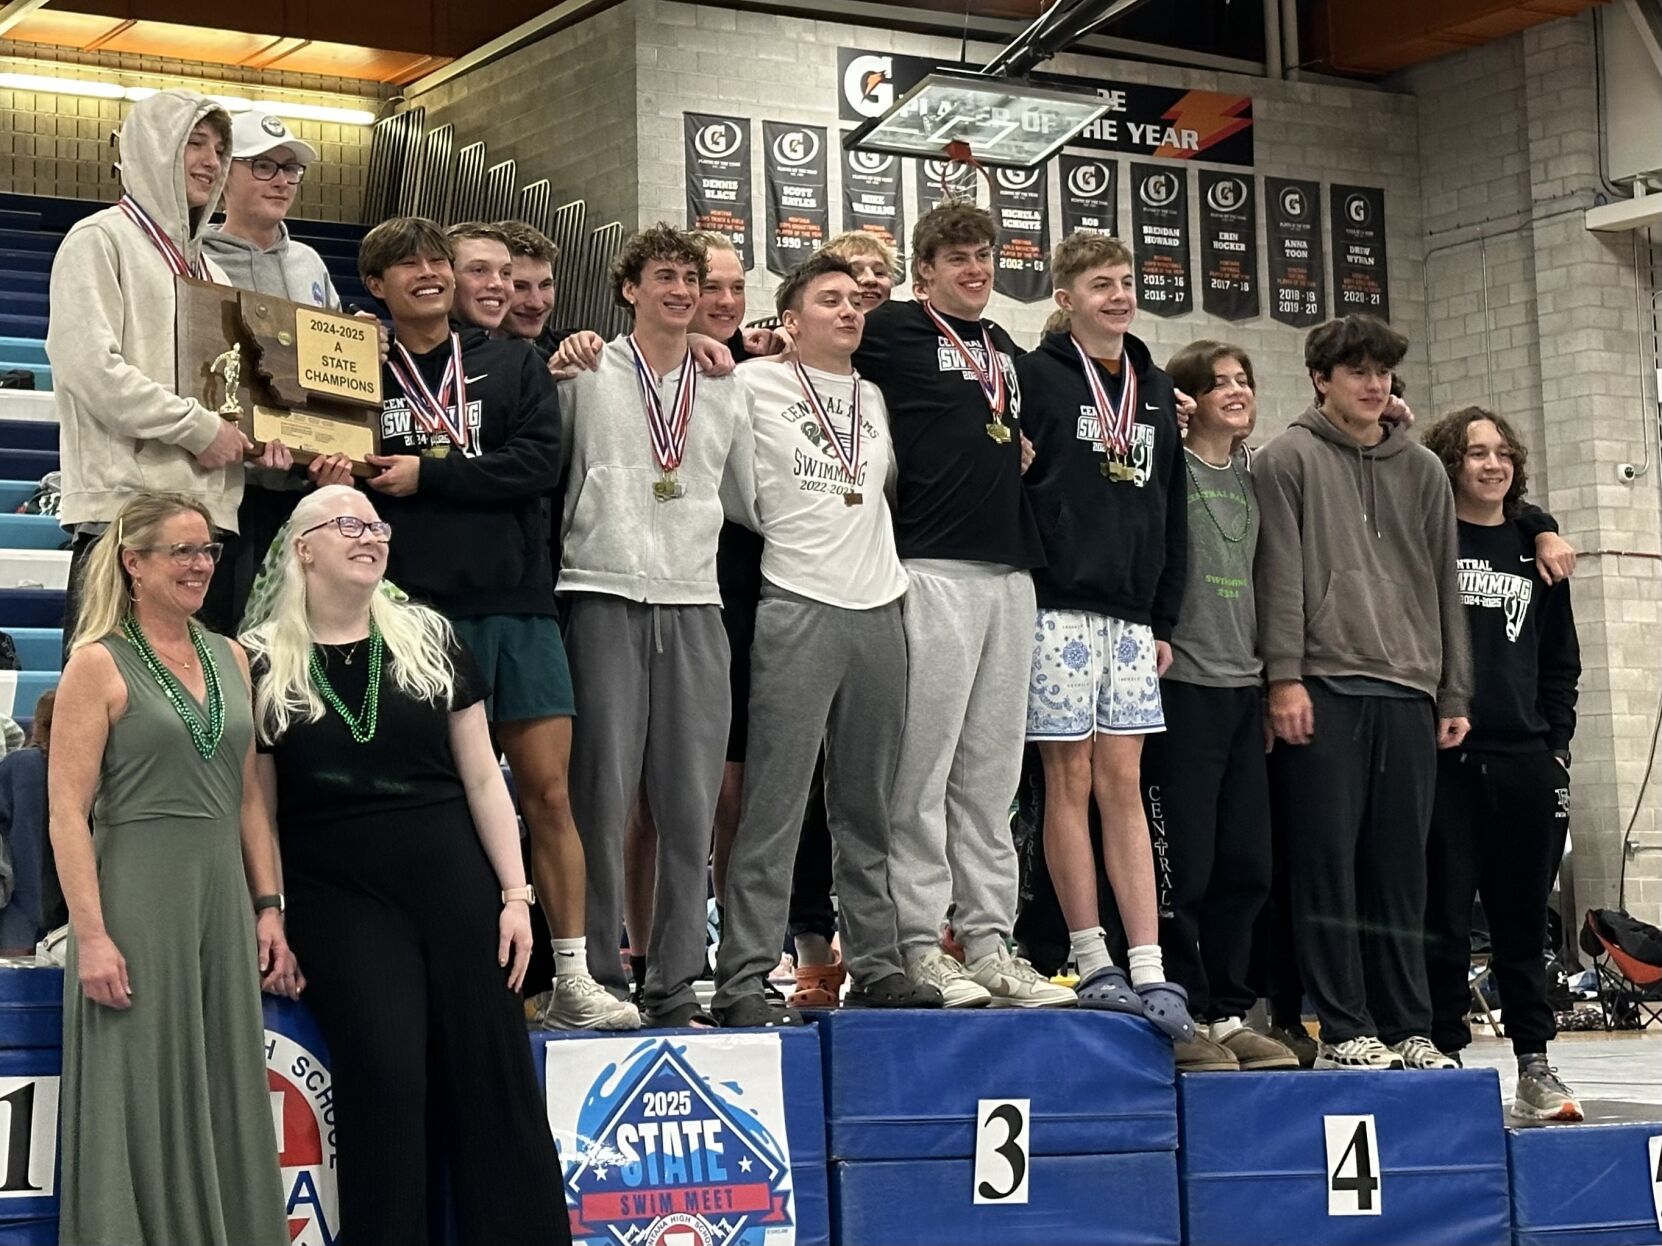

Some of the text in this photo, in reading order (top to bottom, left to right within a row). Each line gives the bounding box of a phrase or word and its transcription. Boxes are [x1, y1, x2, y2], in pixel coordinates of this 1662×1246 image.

[1126, 122, 1198, 150] YEAR
[702, 179, 738, 190] DENNIS
[705, 190, 736, 200] BLACK
[783, 186, 813, 198] SCOTT
[1082, 217, 1098, 226] ROB
[732, 232, 744, 244] 90
[1142, 226, 1180, 237] BRENDAN
[776, 236, 801, 249] 1990
[1144, 236, 1180, 246] HOWARD
[1284, 240, 1308, 249] ANNA
[1285, 250, 1308, 258] TOON
[1350, 246, 1370, 256] DREW
[1000, 258, 1024, 270] 2002
[1144, 274, 1164, 285] 2015
[1174, 276, 1184, 286] 16
[1211, 278, 1230, 290] 2017
[1240, 282, 1250, 292] 18
[1144, 290, 1166, 300] 2016
[1175, 292, 1184, 302] 17
[1279, 288, 1300, 300] 2018
[1306, 291, 1316, 302] 19
[1344, 291, 1364, 304] 2020
[1370, 294, 1380, 304] 21
[1279, 301, 1298, 312] 2019
[1306, 304, 1318, 314] 20
[310, 319, 364, 341] 2024-2025
[334, 342, 342, 353] A
[322, 355, 357, 373] STATE
[305, 368, 374, 394] CHAMPIONS
[1458, 572, 1530, 601] WIMMING
[643, 1091, 692, 1116] 2025
[0, 1082, 42, 1190] 1
[616, 1119, 728, 1188] STATE
[978, 1104, 1026, 1199] 3
[1332, 1121, 1379, 1210] 4
[620, 1188, 734, 1216] SWIM MEET
[670, 1215, 691, 1224] HIGH
